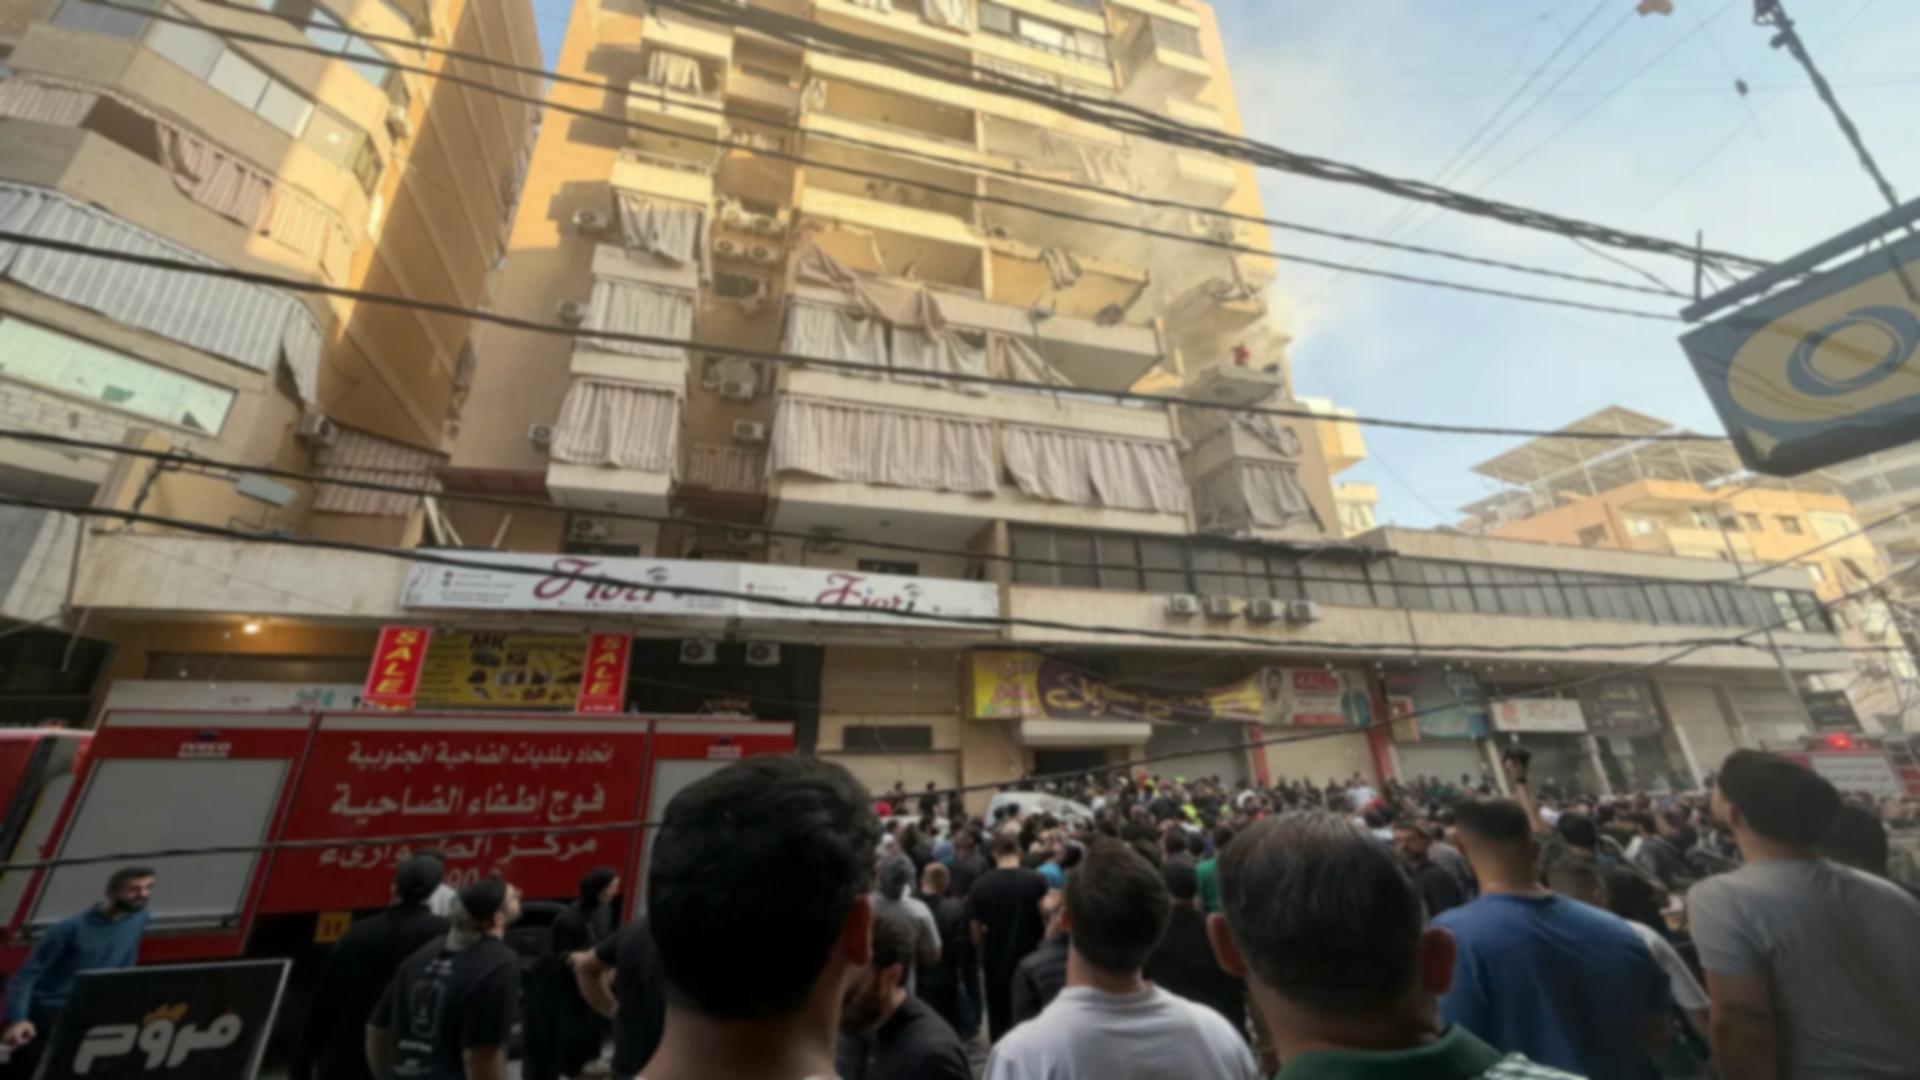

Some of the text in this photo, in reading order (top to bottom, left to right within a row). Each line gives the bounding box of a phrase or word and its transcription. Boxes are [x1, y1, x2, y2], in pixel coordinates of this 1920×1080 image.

[469, 633, 506, 651] MK
[376, 630, 421, 694] SALE
[589, 636, 622, 695] SALE
[180, 741, 232, 752] IVECO
[346, 740, 433, 771] الجنوبية
[436, 740, 511, 770] الضاحية
[511, 741, 573, 769] بلديات
[329, 781, 606, 825] فوج إطفاء الضاحية
[496, 832, 598, 864] مركز
[72, 1005, 243, 1075] فروج
